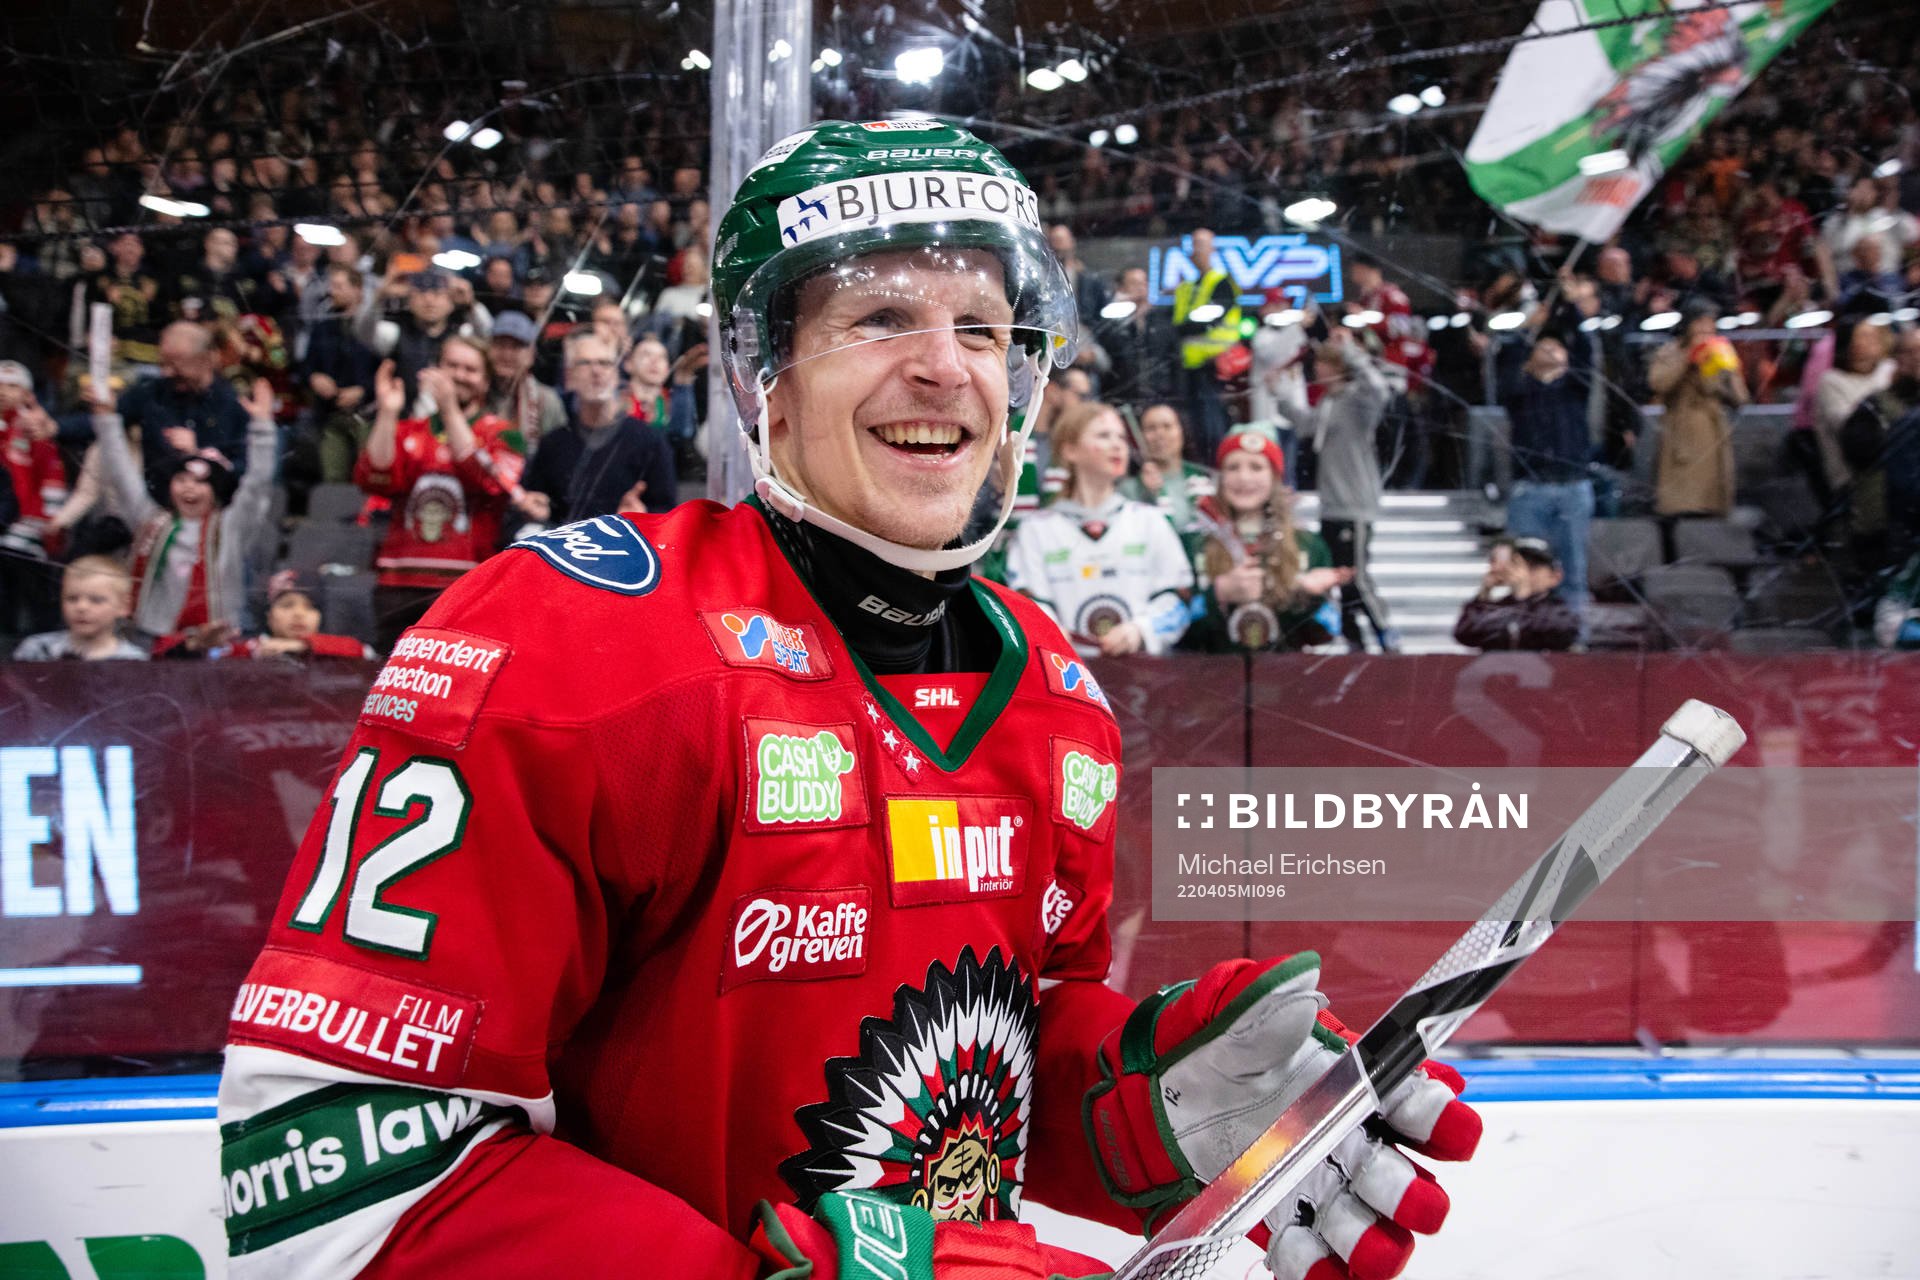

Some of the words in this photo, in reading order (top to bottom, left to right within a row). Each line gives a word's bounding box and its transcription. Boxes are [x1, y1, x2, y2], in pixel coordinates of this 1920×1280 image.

[914, 687, 960, 708] SHL
[763, 742, 820, 778] CASH
[762, 780, 838, 814] BUDDY
[290, 747, 473, 960] 12
[795, 902, 868, 938] Kaffe
[768, 934, 864, 973] greven
[394, 994, 464, 1035] FILM
[1164, 1086, 1182, 1107] 12
